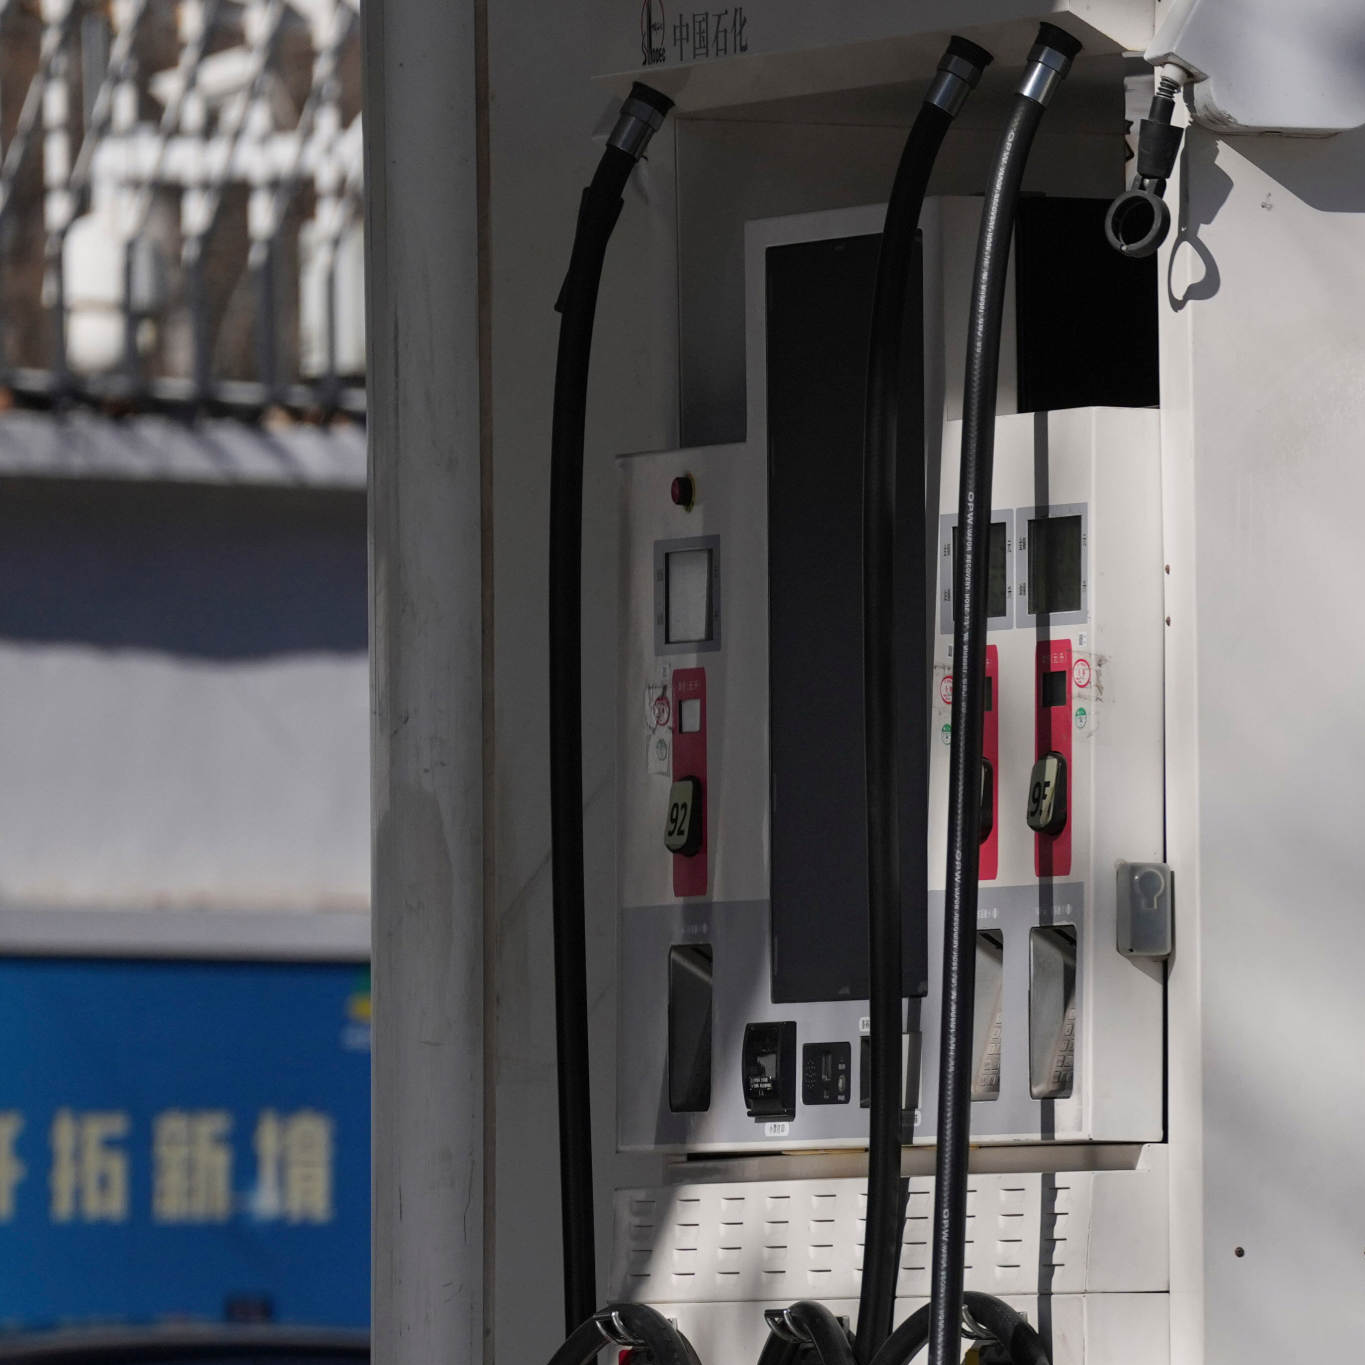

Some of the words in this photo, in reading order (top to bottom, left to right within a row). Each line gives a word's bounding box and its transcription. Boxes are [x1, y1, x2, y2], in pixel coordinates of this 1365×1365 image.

[673, 7, 748, 61] 中国石化
[967, 491, 975, 525] OPW
[668, 803, 688, 837] 92
